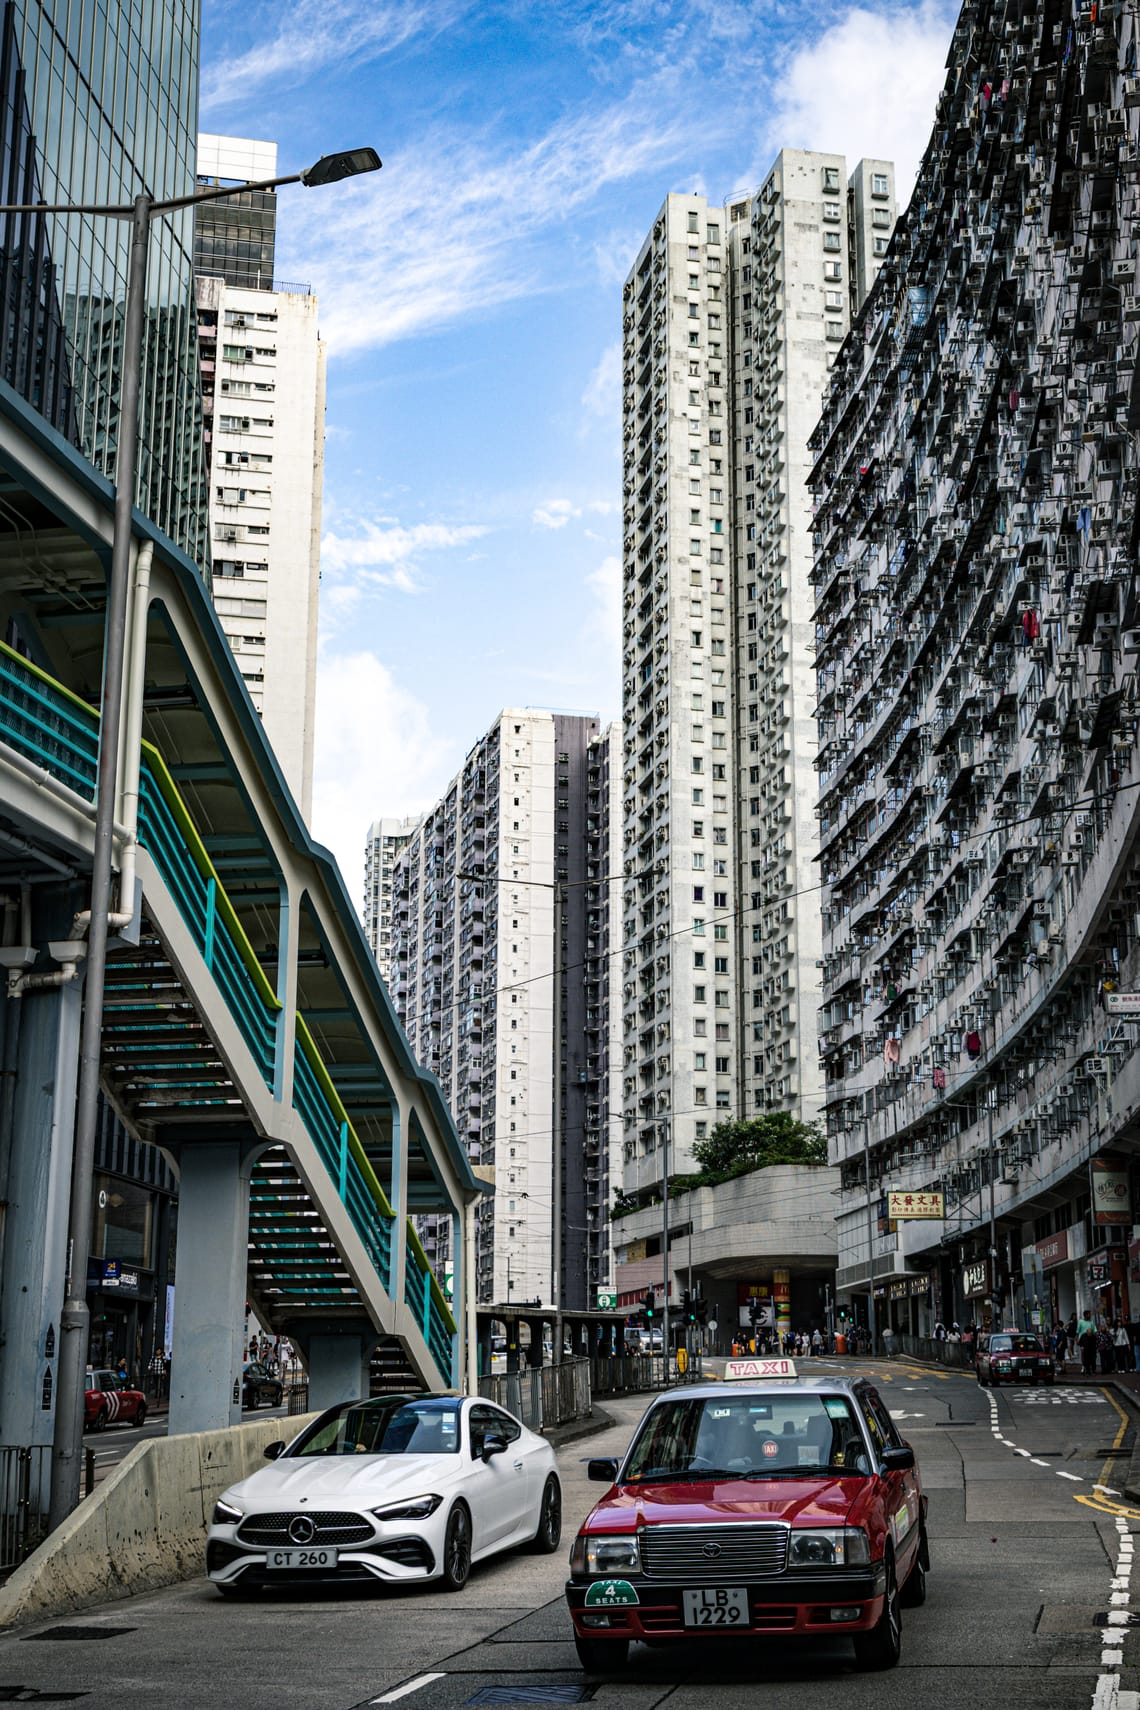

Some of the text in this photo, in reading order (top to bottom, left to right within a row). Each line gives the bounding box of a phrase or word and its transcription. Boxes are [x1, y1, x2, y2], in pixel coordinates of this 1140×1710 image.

[891, 1194, 941, 1206] 大發文具
[730, 1362, 789, 1375] TAXI
[764, 1445, 777, 1454] TAXI
[274, 1551, 328, 1566] CT 260
[605, 1584, 616, 1597] 4
[595, 1596, 628, 1604] SEATS
[701, 1589, 729, 1607] LB
[693, 1606, 741, 1624] 1229
